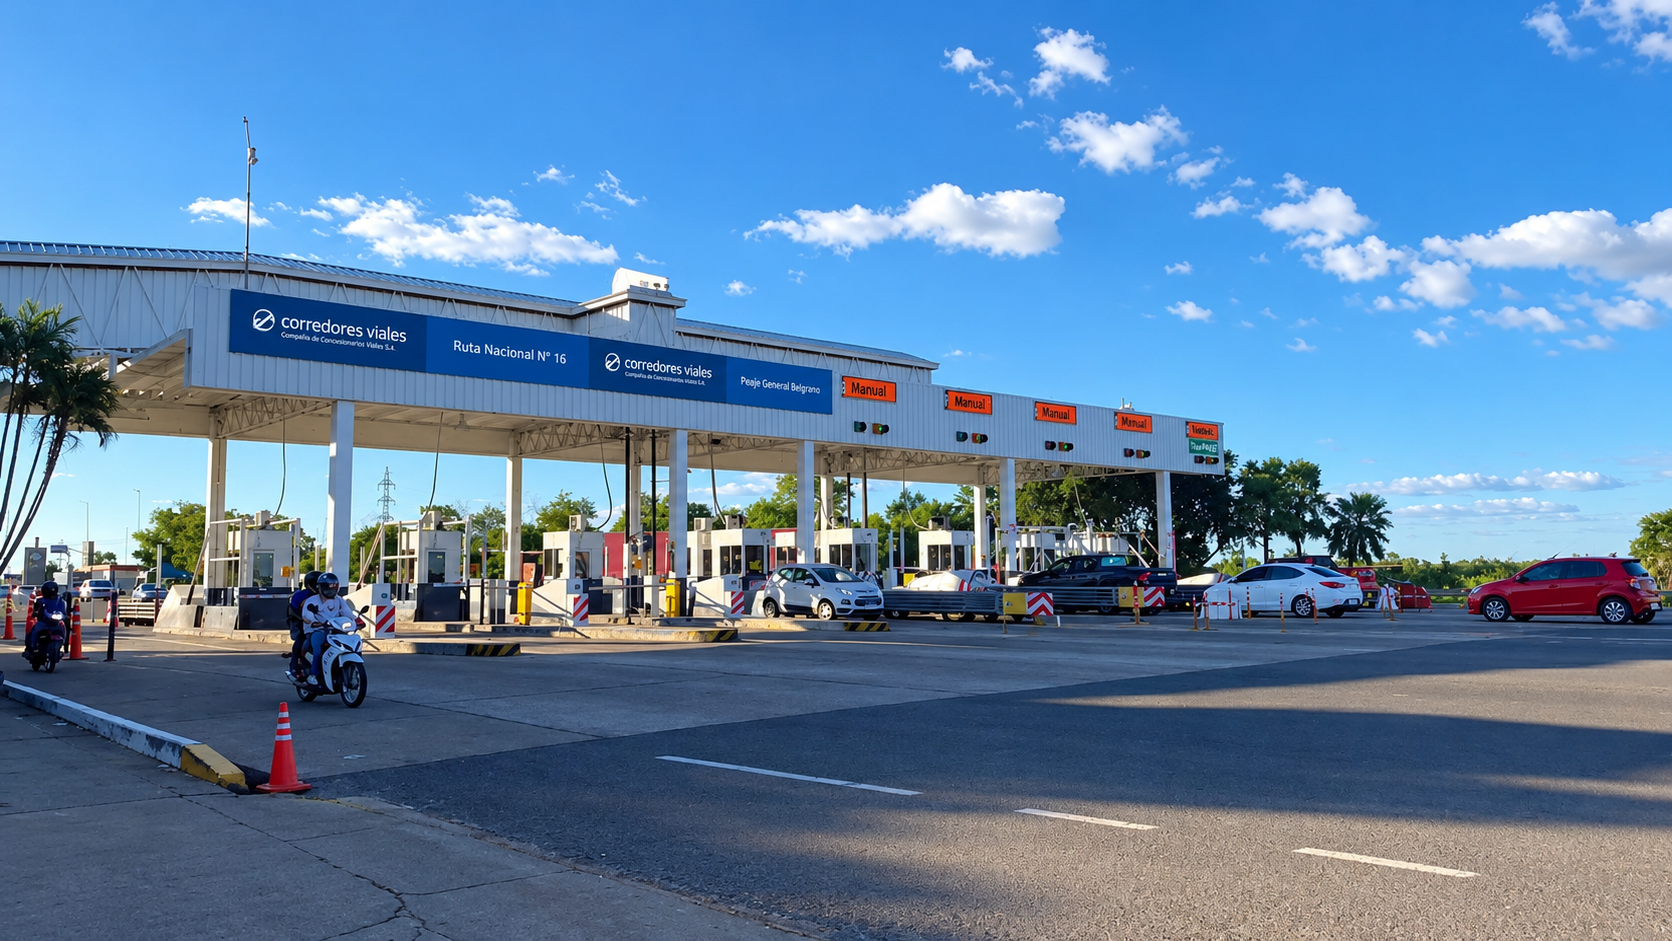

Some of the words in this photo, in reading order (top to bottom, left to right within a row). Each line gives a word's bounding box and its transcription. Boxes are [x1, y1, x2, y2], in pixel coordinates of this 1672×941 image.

[281, 316, 363, 338] corredores
[366, 325, 407, 343] viales
[453, 339, 481, 354] Ruta
[484, 343, 535, 361] Nacional
[554, 353, 567, 365] 16
[624, 358, 683, 375] corredores
[684, 364, 713, 379] viales
[740, 376, 761, 390] Peaje
[762, 378, 790, 391] General
[790, 382, 821, 395] Belgrano
[851, 381, 887, 397] Manual
[954, 395, 986, 410] Manual
[1041, 406, 1070, 421] Manual
